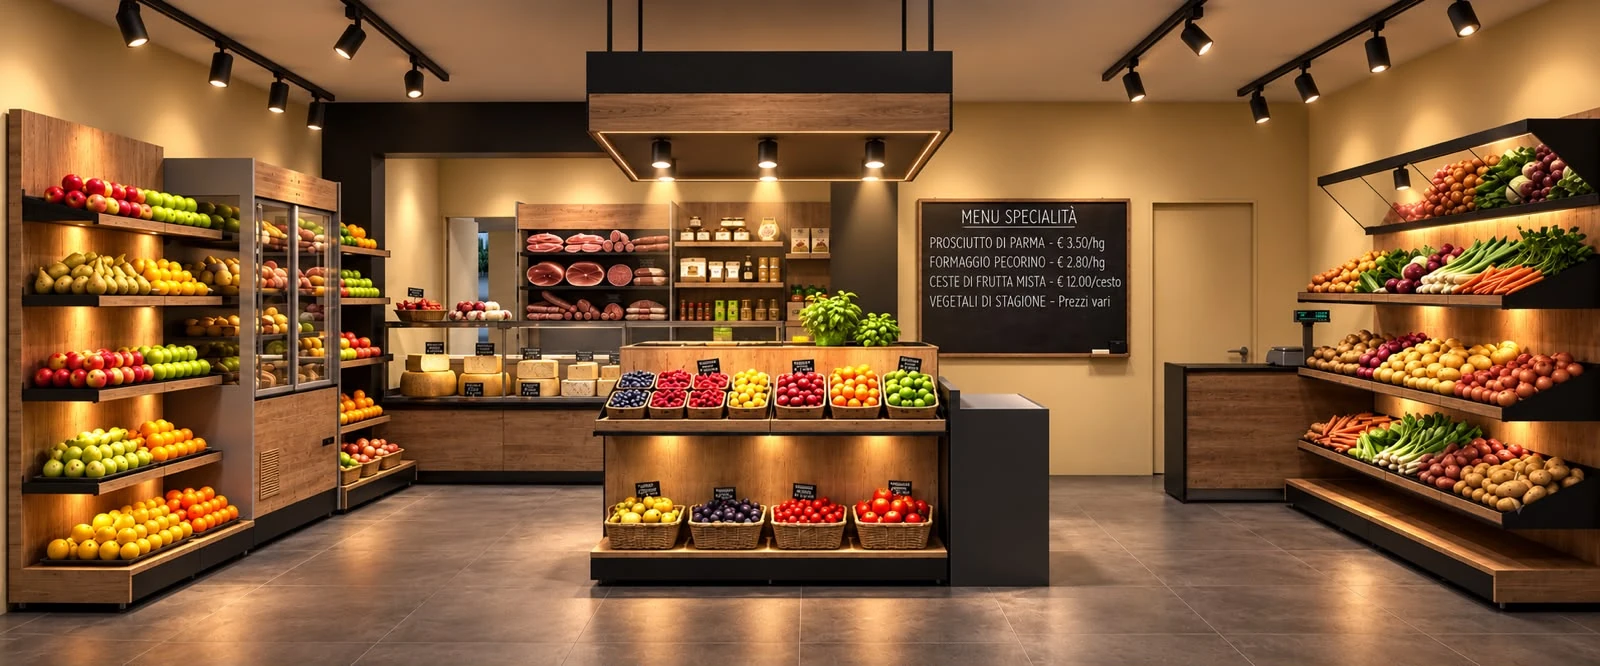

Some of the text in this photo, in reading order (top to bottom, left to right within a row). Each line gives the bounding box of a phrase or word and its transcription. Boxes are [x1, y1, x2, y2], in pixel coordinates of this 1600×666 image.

[962, 206, 1077, 224] MENU SPECIALITÀ
[930, 237, 992, 248] PROSCIUTTO
[997, 237, 1005, 248] DI
[1010, 237, 1045, 248] PARMA
[1057, 237, 1063, 248] €
[1067, 237, 1105, 252] 3.50/hg
[930, 256, 990, 268] FORMAGGIO
[995, 256, 1045, 268] PECORINO
[1057, 256, 1063, 268] €
[1067, 256, 1105, 271] 2.80/hg
[930, 276, 959, 287] CESTE
[964, 276, 972, 287] DI
[977, 276, 1013, 287] FRUTTA
[1017, 276, 1046, 287] MISTA
[1057, 276, 1063, 287] €
[1067, 276, 1121, 288] 12.00/cesto
[930, 295, 977, 307] VEGETALI
[982, 295, 991, 307] DI
[996, 295, 1045, 307] STAGIONE
[1059, 295, 1088, 307] Prezzi
[1092, 296, 1110, 307] vari
